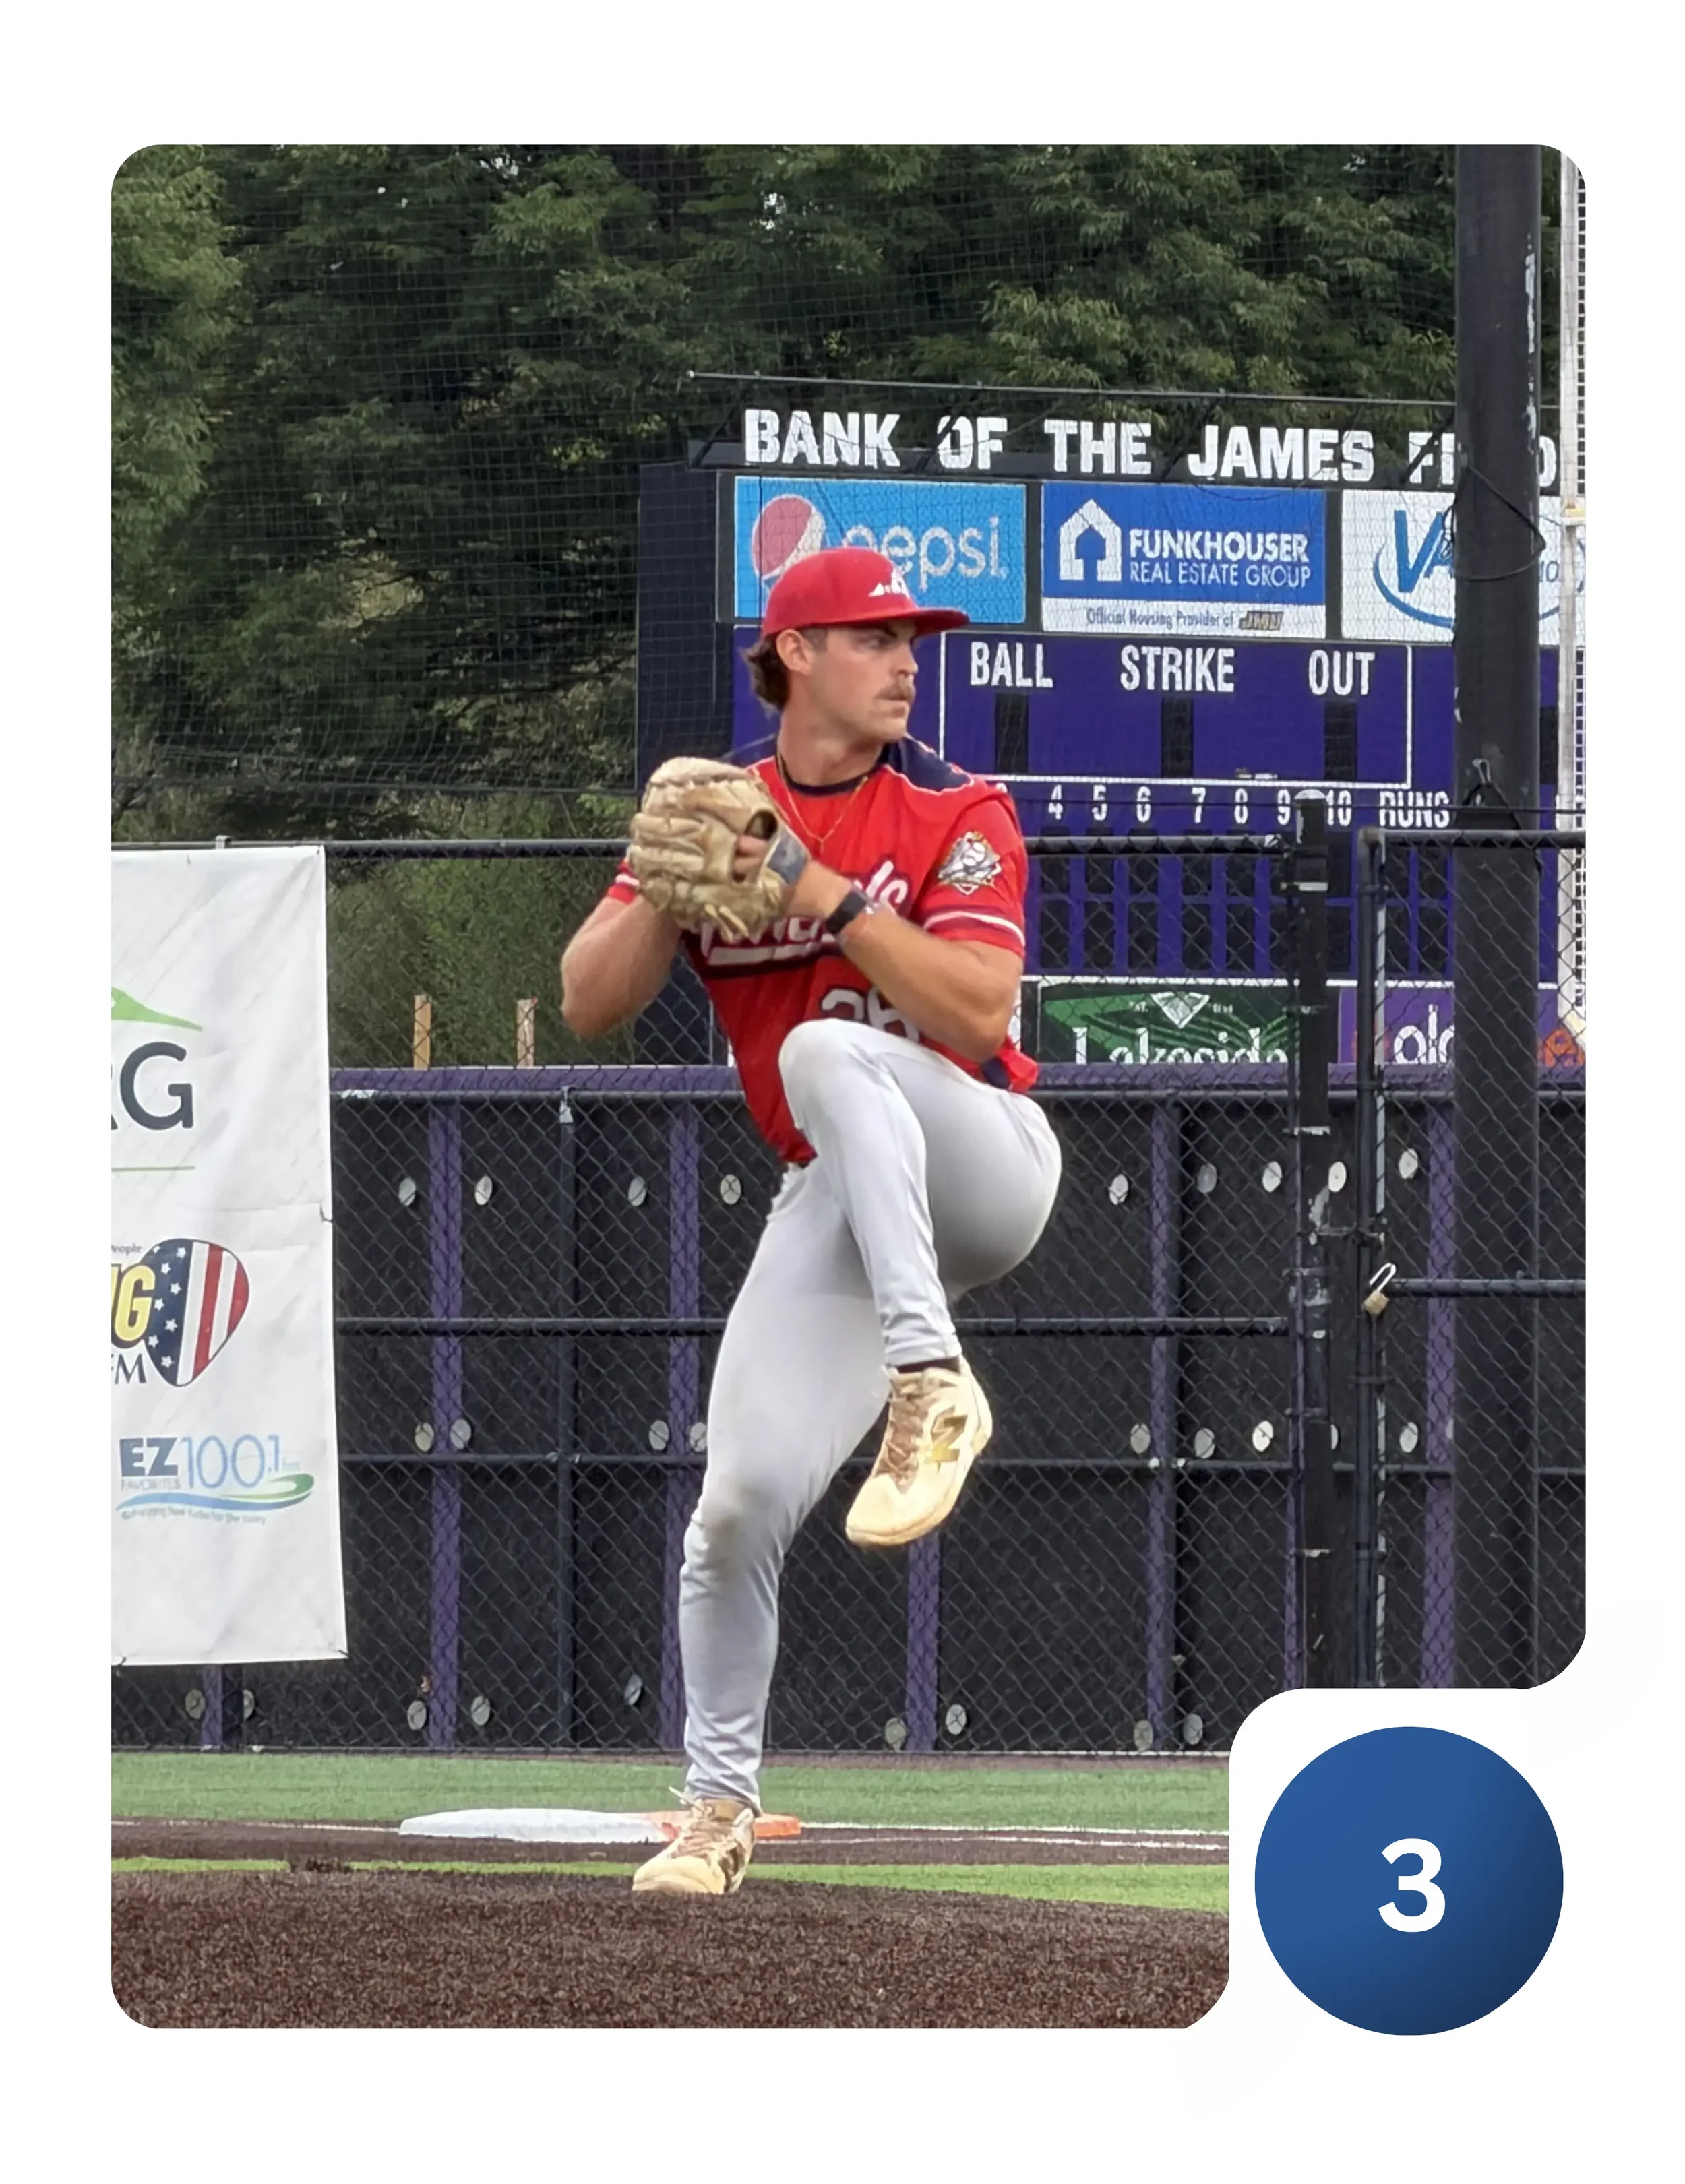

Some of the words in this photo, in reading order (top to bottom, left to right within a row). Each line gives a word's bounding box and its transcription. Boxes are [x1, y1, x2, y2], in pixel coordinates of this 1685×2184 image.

[744, 408, 900, 469] BANK
[937, 415, 1008, 470] OF
[1043, 418, 1151, 475] THE
[1188, 425, 1374, 483] JAMES
[1129, 528, 1310, 563] FUNKHOUSER
[1130, 561, 1173, 584] REAL
[1178, 562, 1239, 586] ESTATE
[1245, 564, 1312, 588] GROUP
[1086, 606, 1126, 626] Official
[1128, 608, 1173, 631] Housing
[1176, 610, 1219, 627] Provider
[1223, 611, 1235, 627] of
[971, 642, 1053, 688] BALL
[1120, 644, 1235, 693] STRIKE
[1308, 649, 1376, 696] OUT
[1048, 784, 1063, 820] 4
[1091, 784, 1108, 821] 5
[1136, 786, 1151, 823] 6
[1191, 786, 1206, 824] 7
[1234, 788, 1249, 825] 8
[1277, 788, 1291, 826] 9
[1325, 789, 1353, 827] 10
[1379, 790, 1450, 828] RUNS
[119, 1437, 179, 1477] EZ
[180, 1433, 280, 1489] 100.1
